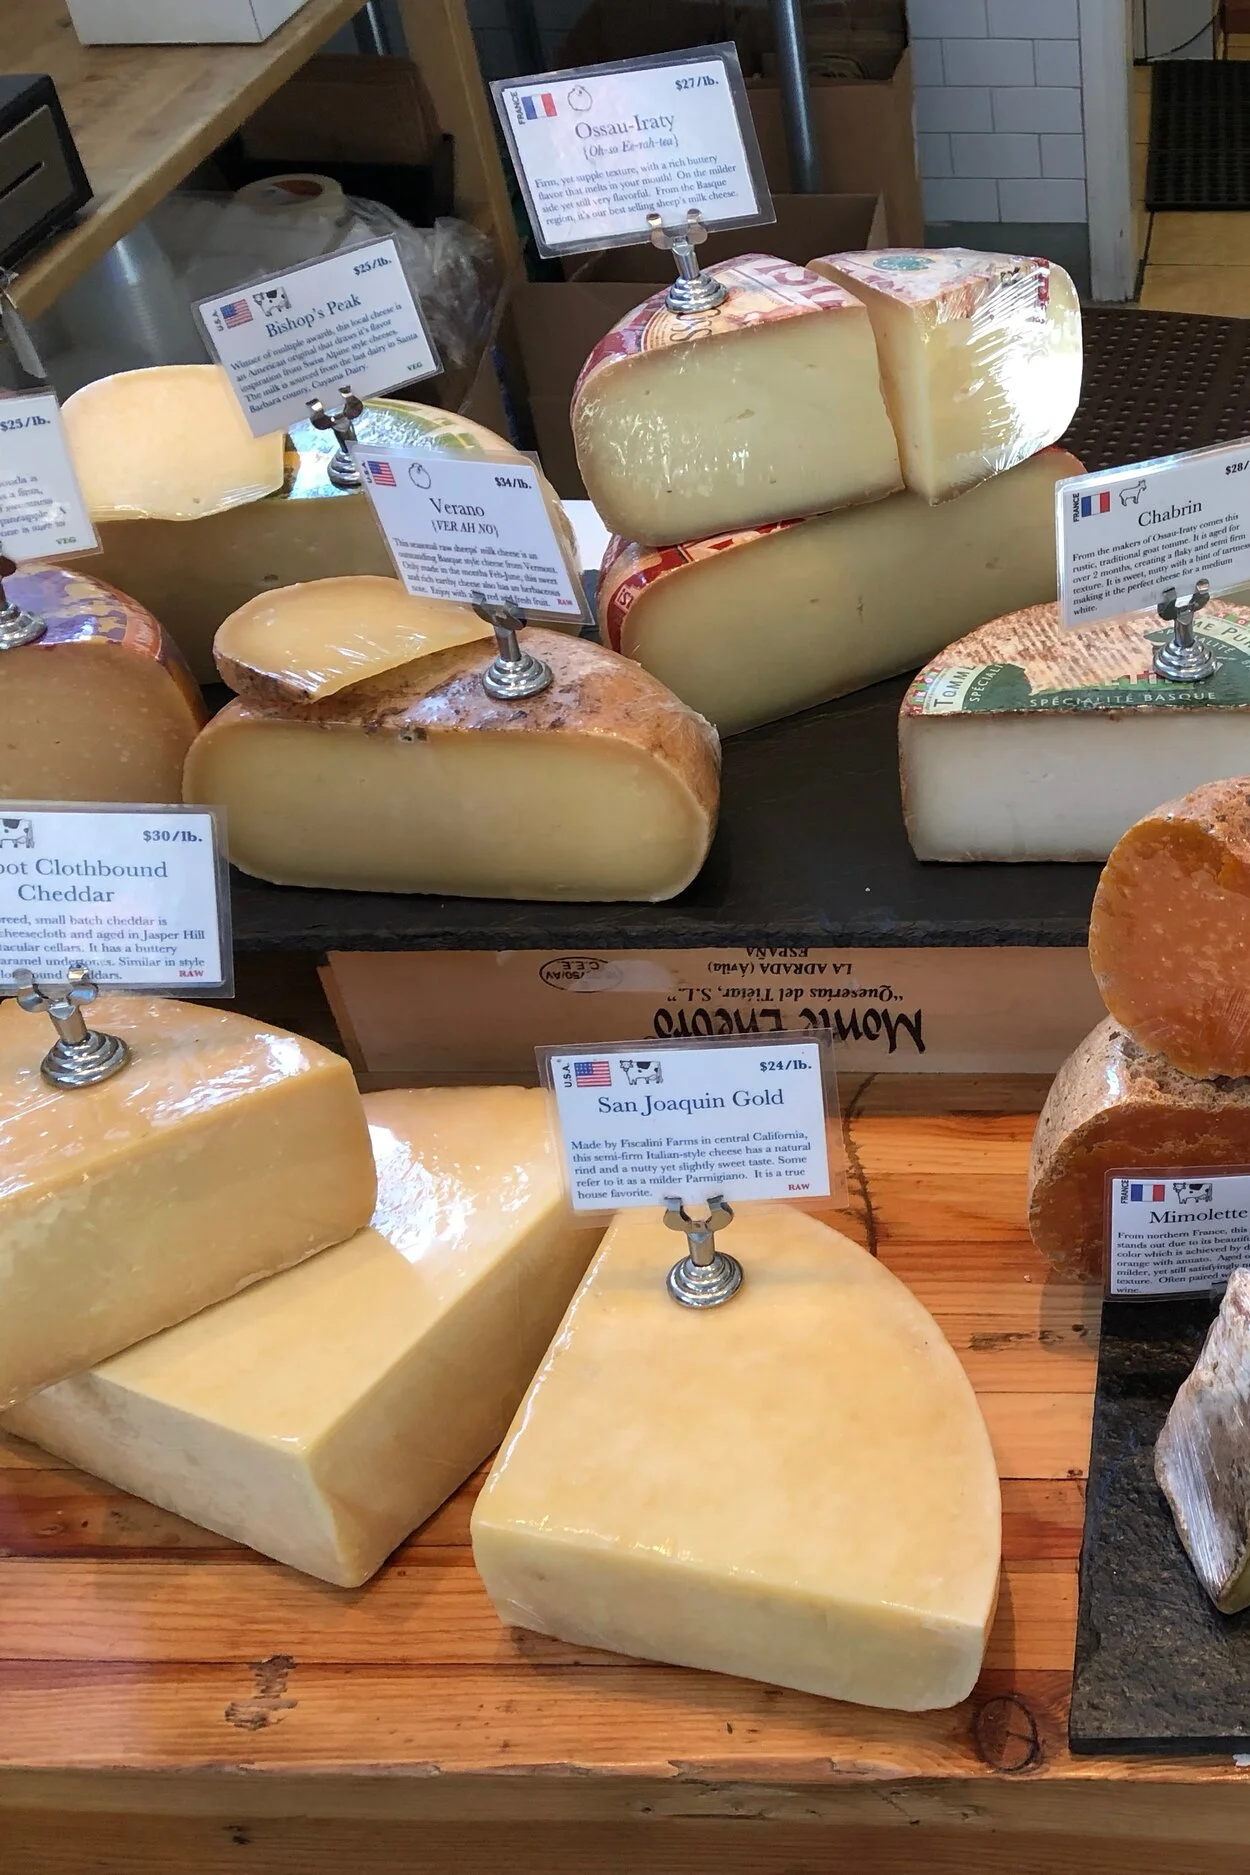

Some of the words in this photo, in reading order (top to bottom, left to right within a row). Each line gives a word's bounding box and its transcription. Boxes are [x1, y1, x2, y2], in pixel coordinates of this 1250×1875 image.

[675, 75, 719, 91] $27/lb.
[513, 91, 525, 125] FRANCE
[575, 114, 674, 139] Ossau-Iraty
[353, 257, 392, 276] $25/lb.
[265, 308, 325, 338] Bishop's
[326, 294, 361, 315] Peak
[406, 361, 423, 371] VEG
[0, 415, 51, 432] $25/lb.
[494, 476, 532, 489] $34/lb.
[430, 498, 485, 517] Verano
[1072, 492, 1080, 522] FRANCE
[1138, 500, 1202, 527] Chabrin
[460, 521, 476, 533] AH
[1072, 551, 1096, 562] From
[1096, 547, 1110, 556] the
[1112, 540, 1141, 552] makers
[1142, 534, 1152, 544] of
[1152, 525, 1198, 542] Ossau-Iraty
[1198, 518, 1224, 529] comes
[1224, 513, 1239, 523] this
[1072, 561, 1097, 573] rustic,
[1099, 549, 1141, 566] traditional
[1142, 545, 1160, 558] goat
[1161, 538, 1189, 550] tomme.
[1192, 533, 1199, 542] It
[1200, 531, 1208, 540] is
[1208, 525, 1228, 538] aged
[1228, 523, 1240, 533] for
[1030, 694, 1134, 708] SPÉCIALITÉ
[1144, 691, 1216, 702] BASQUE
[143, 830, 202, 842] $30/lb.
[35, 858, 167, 878] Clothbound
[17, 884, 114, 902] Cheddar
[34, 914, 66, 925] small
[69, 914, 103, 926] batch
[106, 915, 154, 926] cheddar
[157, 916, 168, 926] is
[746, 947, 809, 958] ESPAÑA
[178, 969, 204, 978] RAW
[759, 962, 829, 975] ADRADA
[834, 962, 853, 975] LA
[779, 985, 804, 1001] del
[800, 1007, 926, 1054] Monte
[759, 1059, 812, 1072] $24/lb.
[563, 1063, 572, 1087] U.S.A.
[598, 1096, 638, 1113] San
[641, 1092, 725, 1115] Joaquin
[732, 1088, 784, 1107] Gold
[571, 1140, 601, 1150] Made
[603, 1139, 618, 1151] by
[620, 1137, 663, 1148] Fiscalini
[665, 1137, 699, 1147] Farms
[700, 1135, 712, 1145] in
[714, 1132, 750, 1144] central
[752, 1130, 808, 1141] California,
[788, 1183, 810, 1191] RAW
[1121, 1180, 1129, 1204] FRANCE
[1150, 1208, 1247, 1224] Mimolette
[1117, 1231, 1144, 1240] From
[1146, 1231, 1189, 1239] northern
[1192, 1229, 1228, 1237] France,
[1230, 1226, 1248, 1234] this
